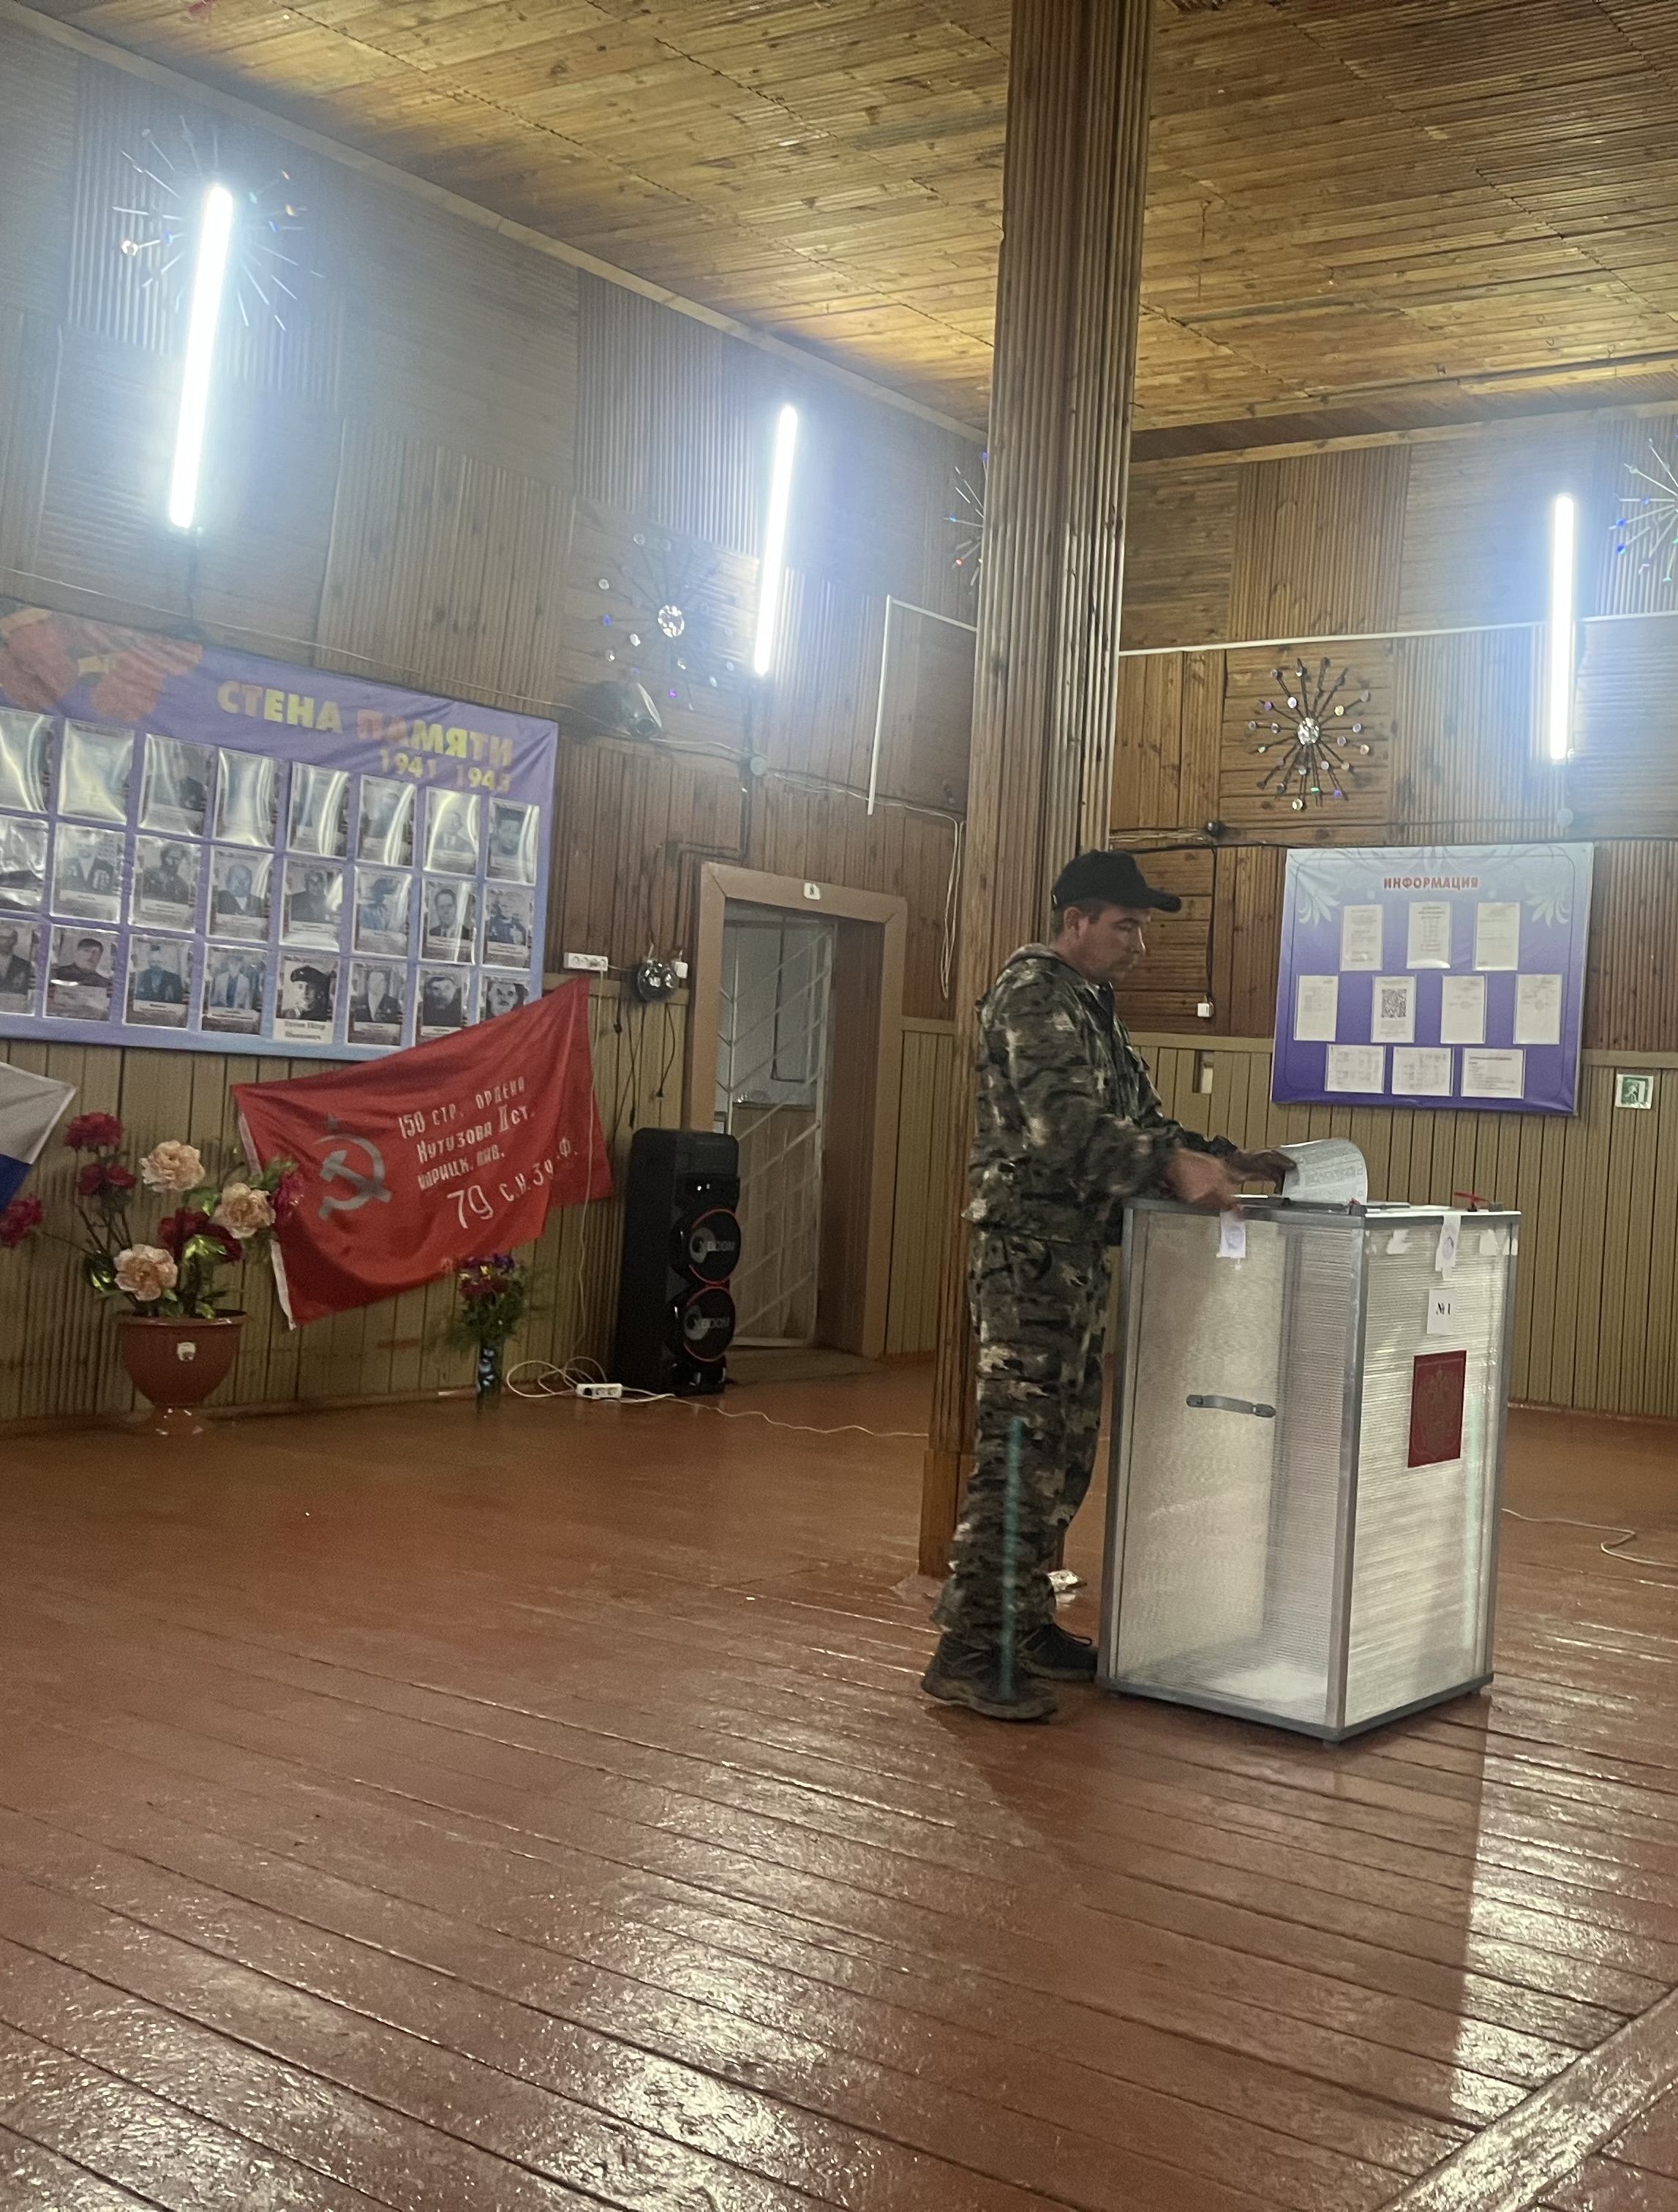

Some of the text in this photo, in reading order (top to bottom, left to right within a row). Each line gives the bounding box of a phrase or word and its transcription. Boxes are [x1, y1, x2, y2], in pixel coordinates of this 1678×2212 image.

[218, 680, 513, 767] СТЕНА ПАМЯТИ
[380, 748, 437, 778] 1941
[1384, 876, 1478, 890] ИНФОРМАЦИЯ
[398, 1111, 426, 1139] 150
[446, 1184, 494, 1229] 79
